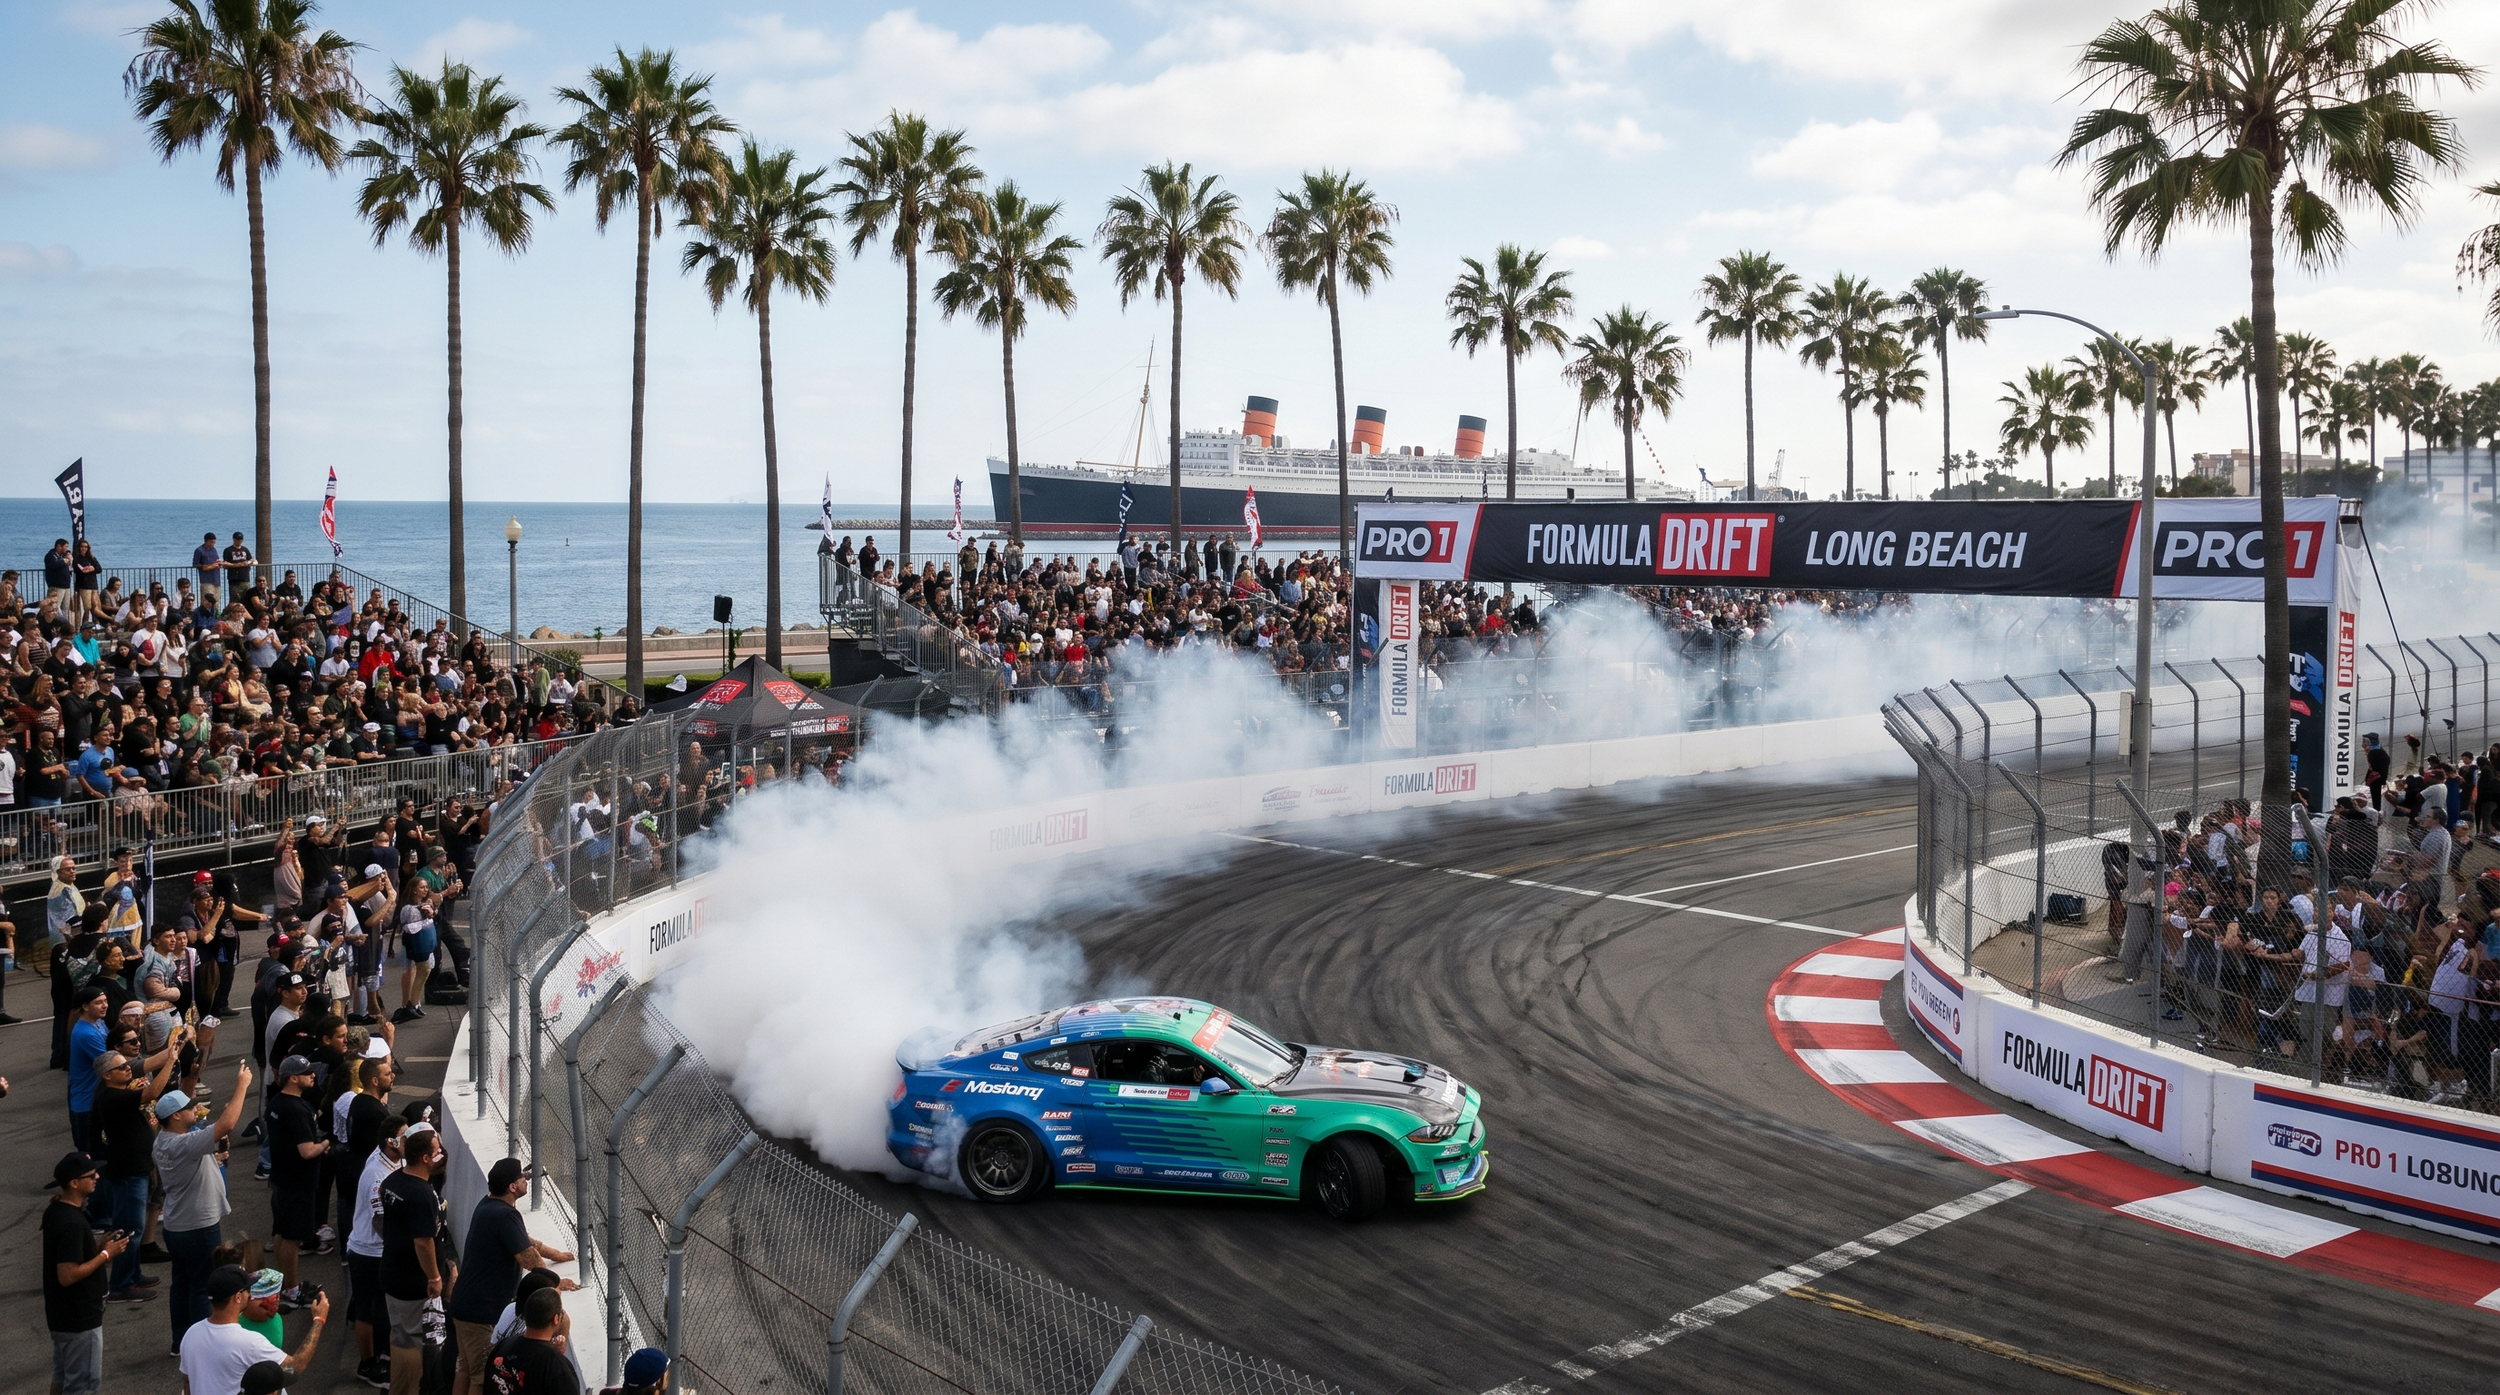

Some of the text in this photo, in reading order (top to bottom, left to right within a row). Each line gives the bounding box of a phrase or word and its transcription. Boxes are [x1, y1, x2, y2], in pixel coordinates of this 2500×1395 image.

[1365, 527, 1432, 557] PRO
[1527, 518, 1768, 571] FORMULA DRIFT
[1805, 530, 2028, 569] LONG BEACH
[1391, 588, 1410, 717] FORMULA DRIFT
[2336, 615, 2354, 788] FORMULA DRIFT
[1384, 765, 1474, 796] FORMULA DRIFT
[989, 810, 1086, 854] FORMULA DRIFT
[649, 909, 693, 955] FORMULA
[2003, 1030, 2163, 1125] FORMULA DRIFT
[2335, 1138, 2381, 1169] PRO
[2388, 1152, 2397, 1174] 1
